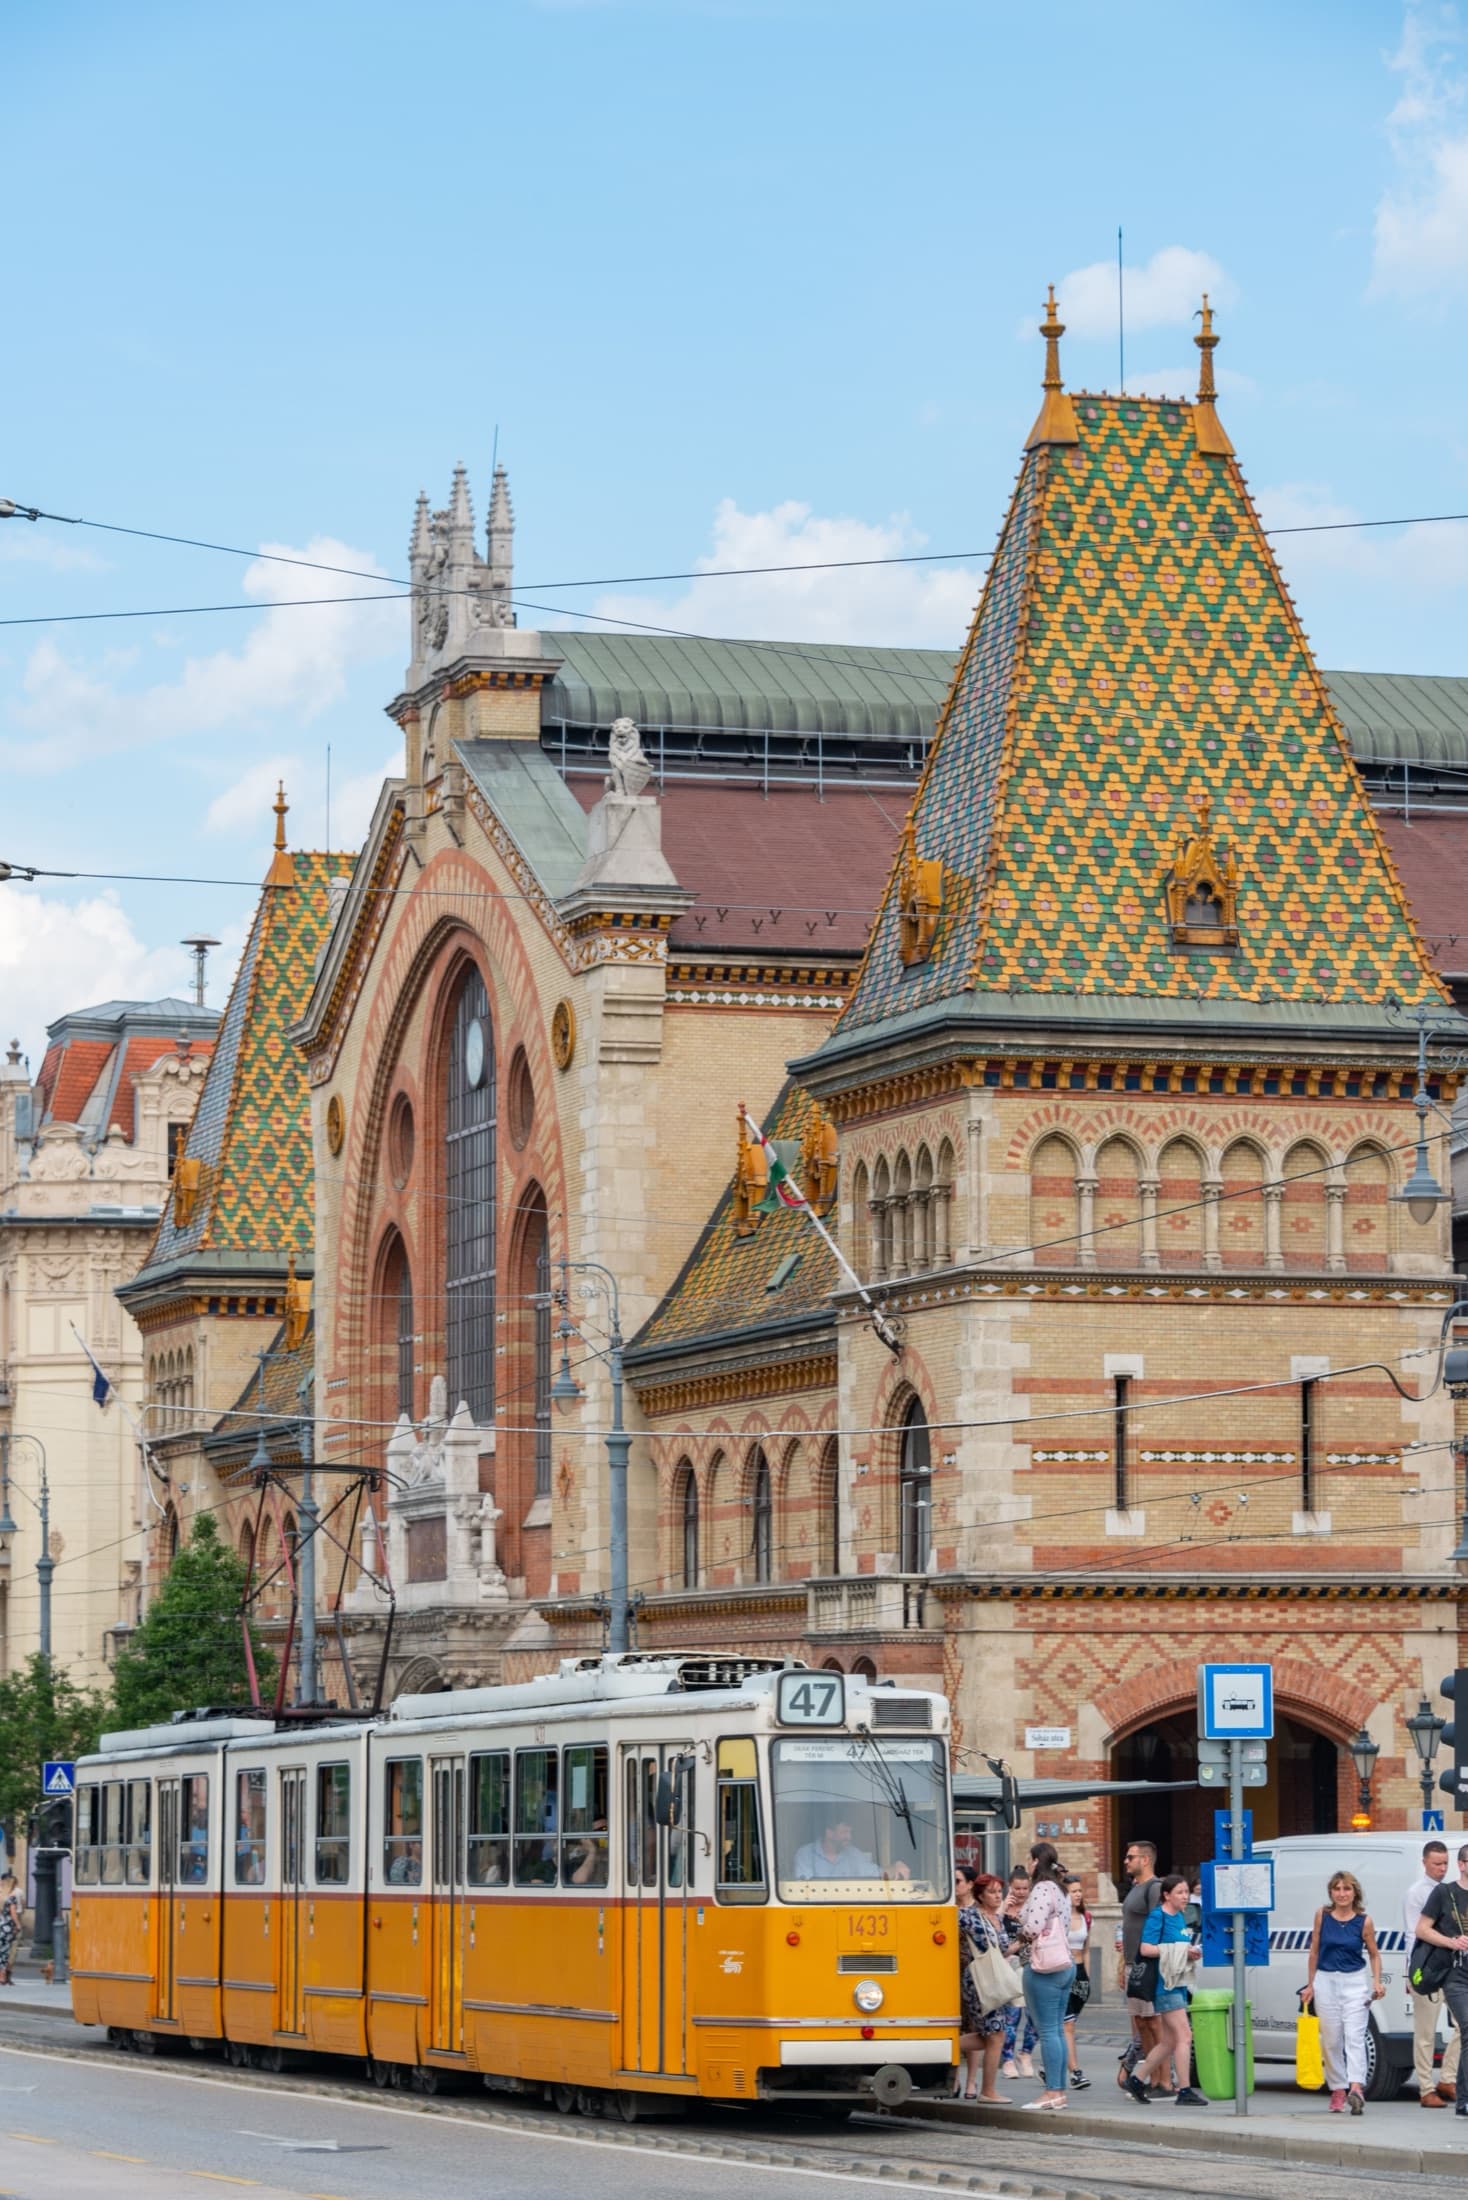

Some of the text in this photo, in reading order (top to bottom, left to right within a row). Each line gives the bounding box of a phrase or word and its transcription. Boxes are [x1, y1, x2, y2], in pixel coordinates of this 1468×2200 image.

[789, 1683, 836, 1717] 47
[846, 1743, 868, 1759] 47
[848, 1915, 888, 1937] 1433
